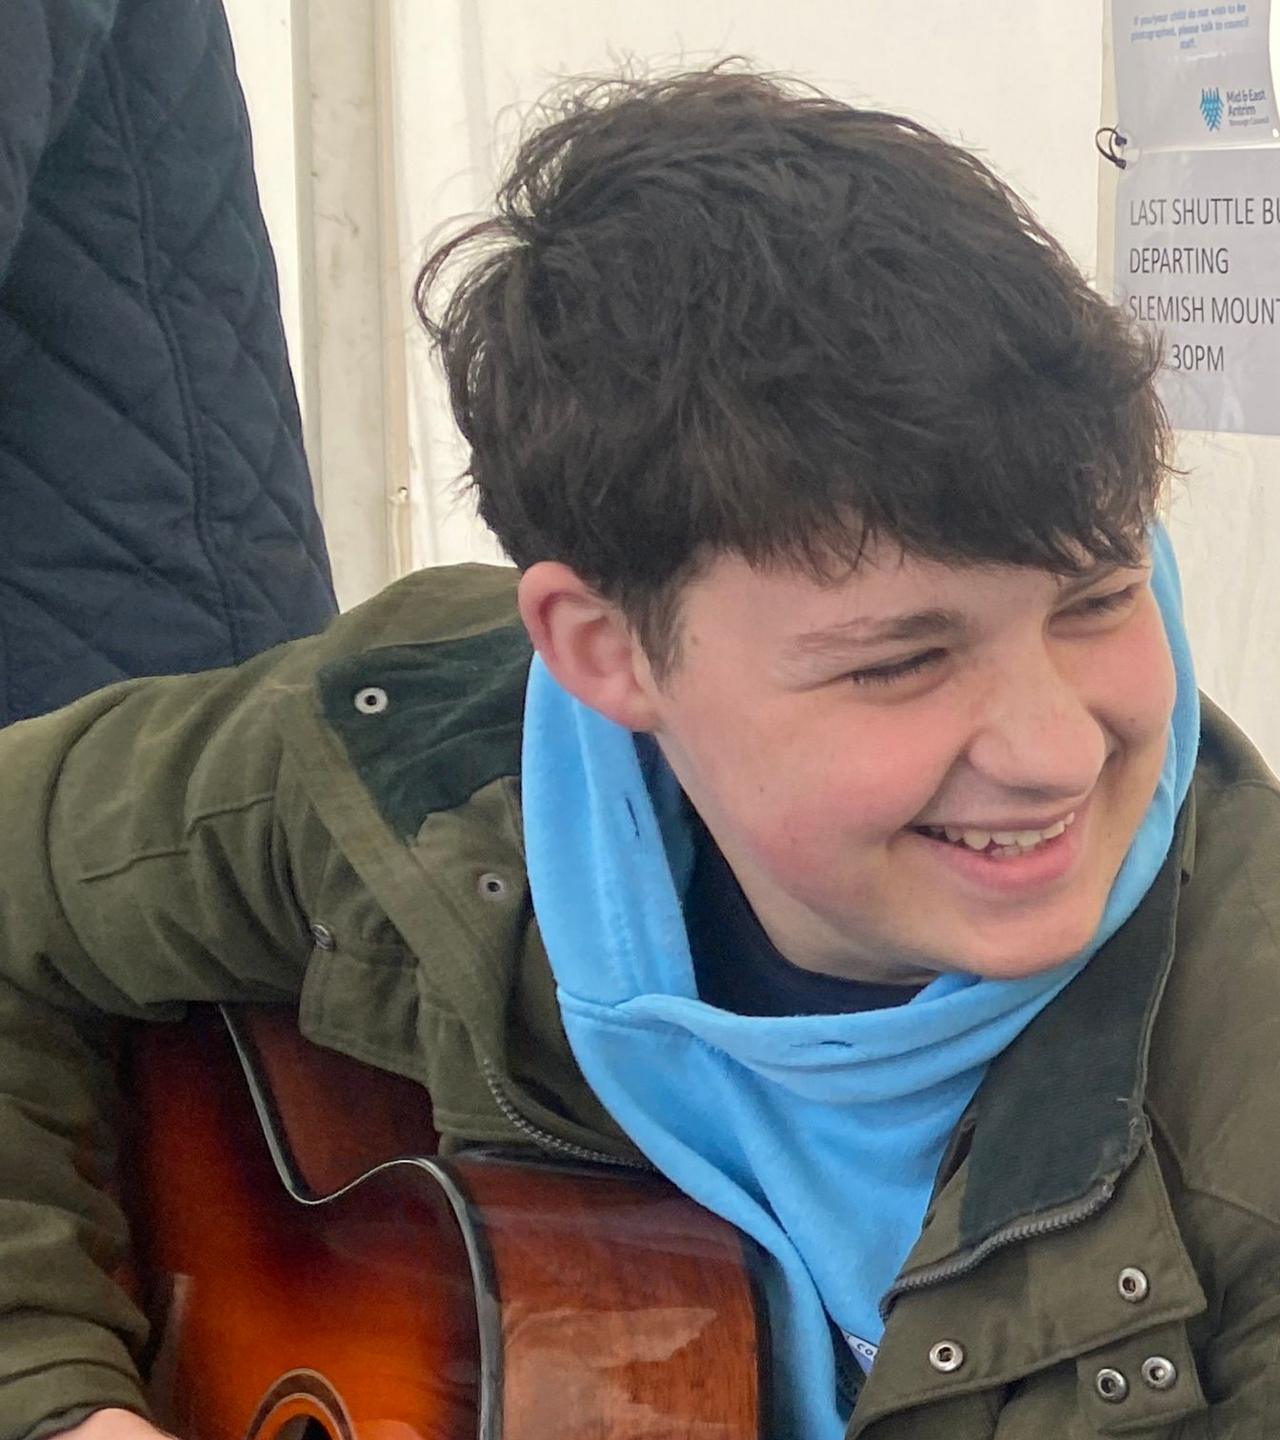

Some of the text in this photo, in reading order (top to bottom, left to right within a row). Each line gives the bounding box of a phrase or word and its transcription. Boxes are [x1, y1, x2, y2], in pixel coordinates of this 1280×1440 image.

[1226, 90, 1241, 103] Mid
[1248, 88, 1266, 101] East
[1228, 105, 1256, 117] Antrim
[1130, 198, 1167, 226] LAST
[1172, 197, 1255, 226] SHUTTLE
[1129, 247, 1229, 275] DEPARTING
[1129, 295, 1205, 323] SLEMISH
[1171, 343, 1224, 372] 30PM
